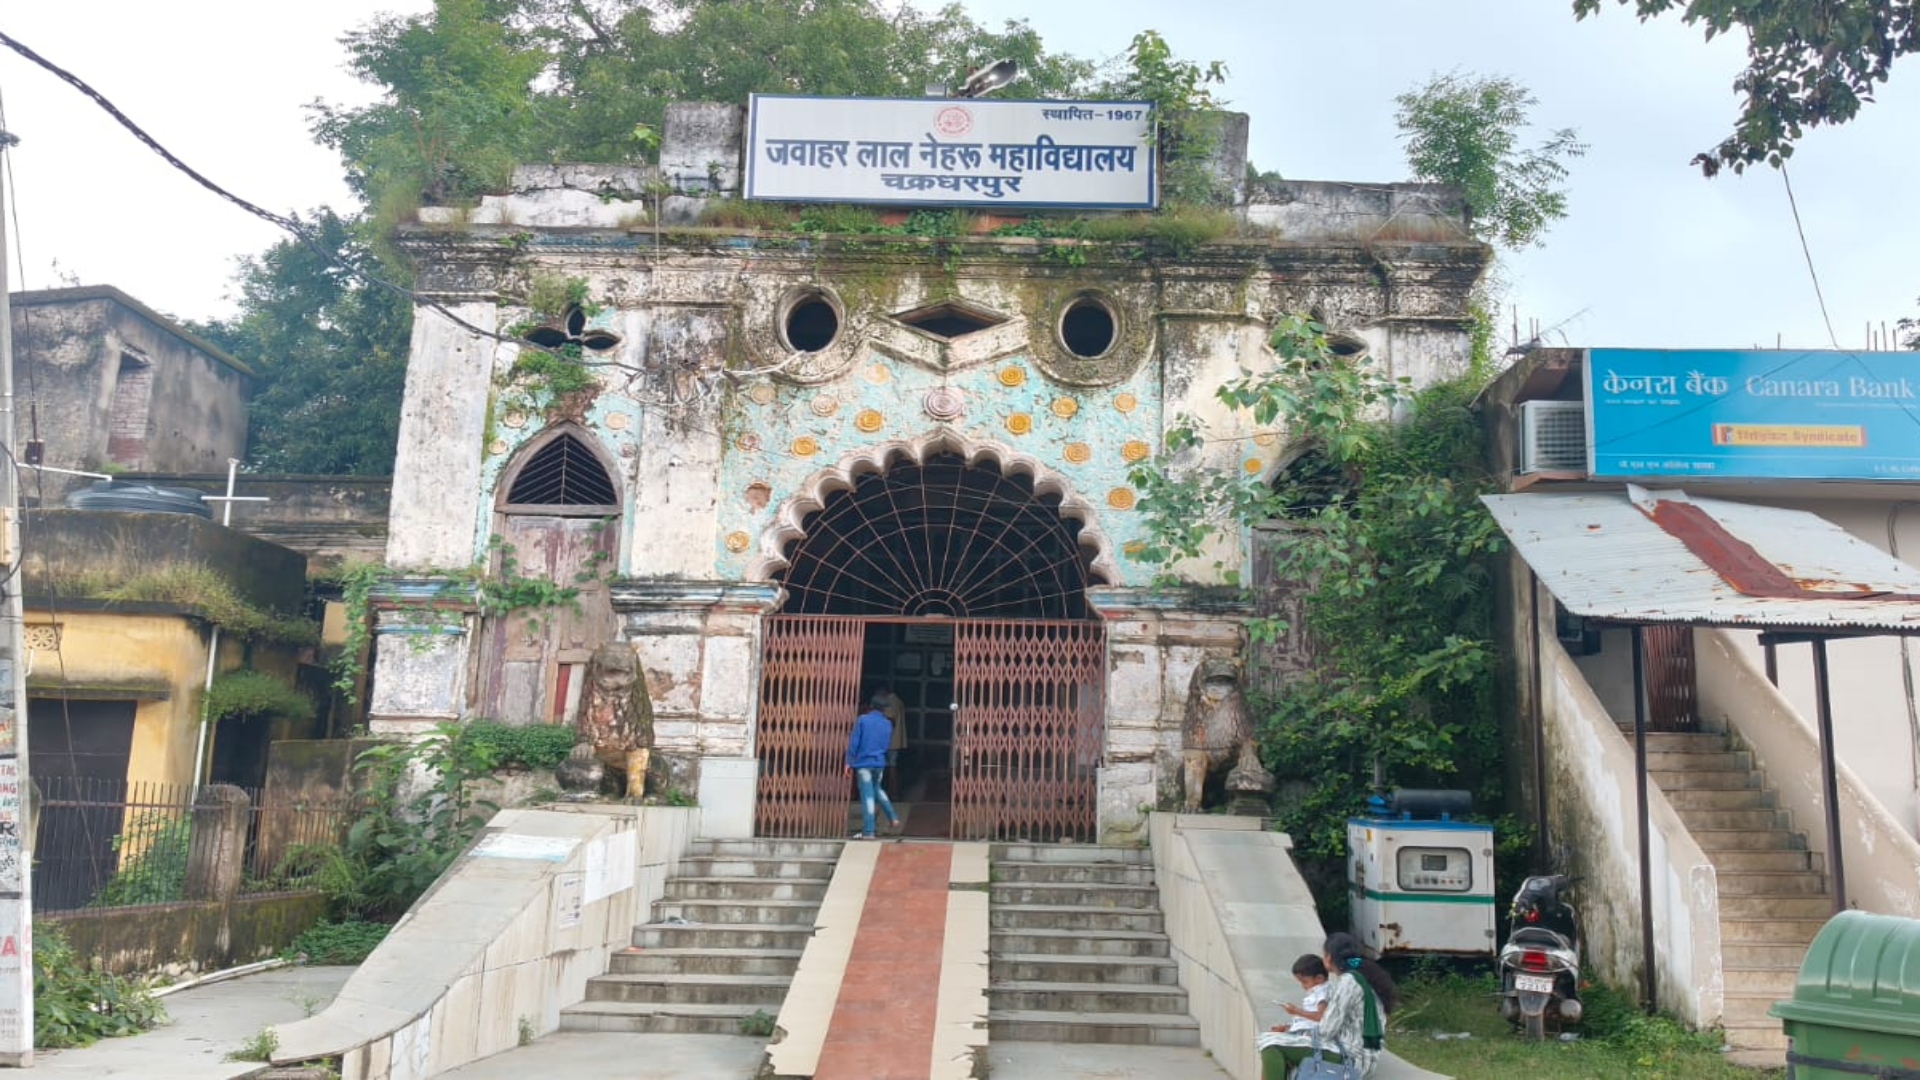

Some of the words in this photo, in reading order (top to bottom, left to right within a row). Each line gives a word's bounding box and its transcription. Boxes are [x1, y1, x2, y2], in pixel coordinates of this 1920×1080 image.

[765, 139, 849, 168] जवाहर
[856, 141, 913, 168] लाल
[919, 132, 983, 170] नेहरू
[988, 134, 1137, 172] महाविद्यालय
[880, 173, 1023, 197] चक्रधरपुर
[1602, 369, 1677, 395] केनरा
[1685, 369, 1729, 396] बैंक
[1745, 375, 1840, 397] Canara
[1850, 376, 1916, 398] Bank
